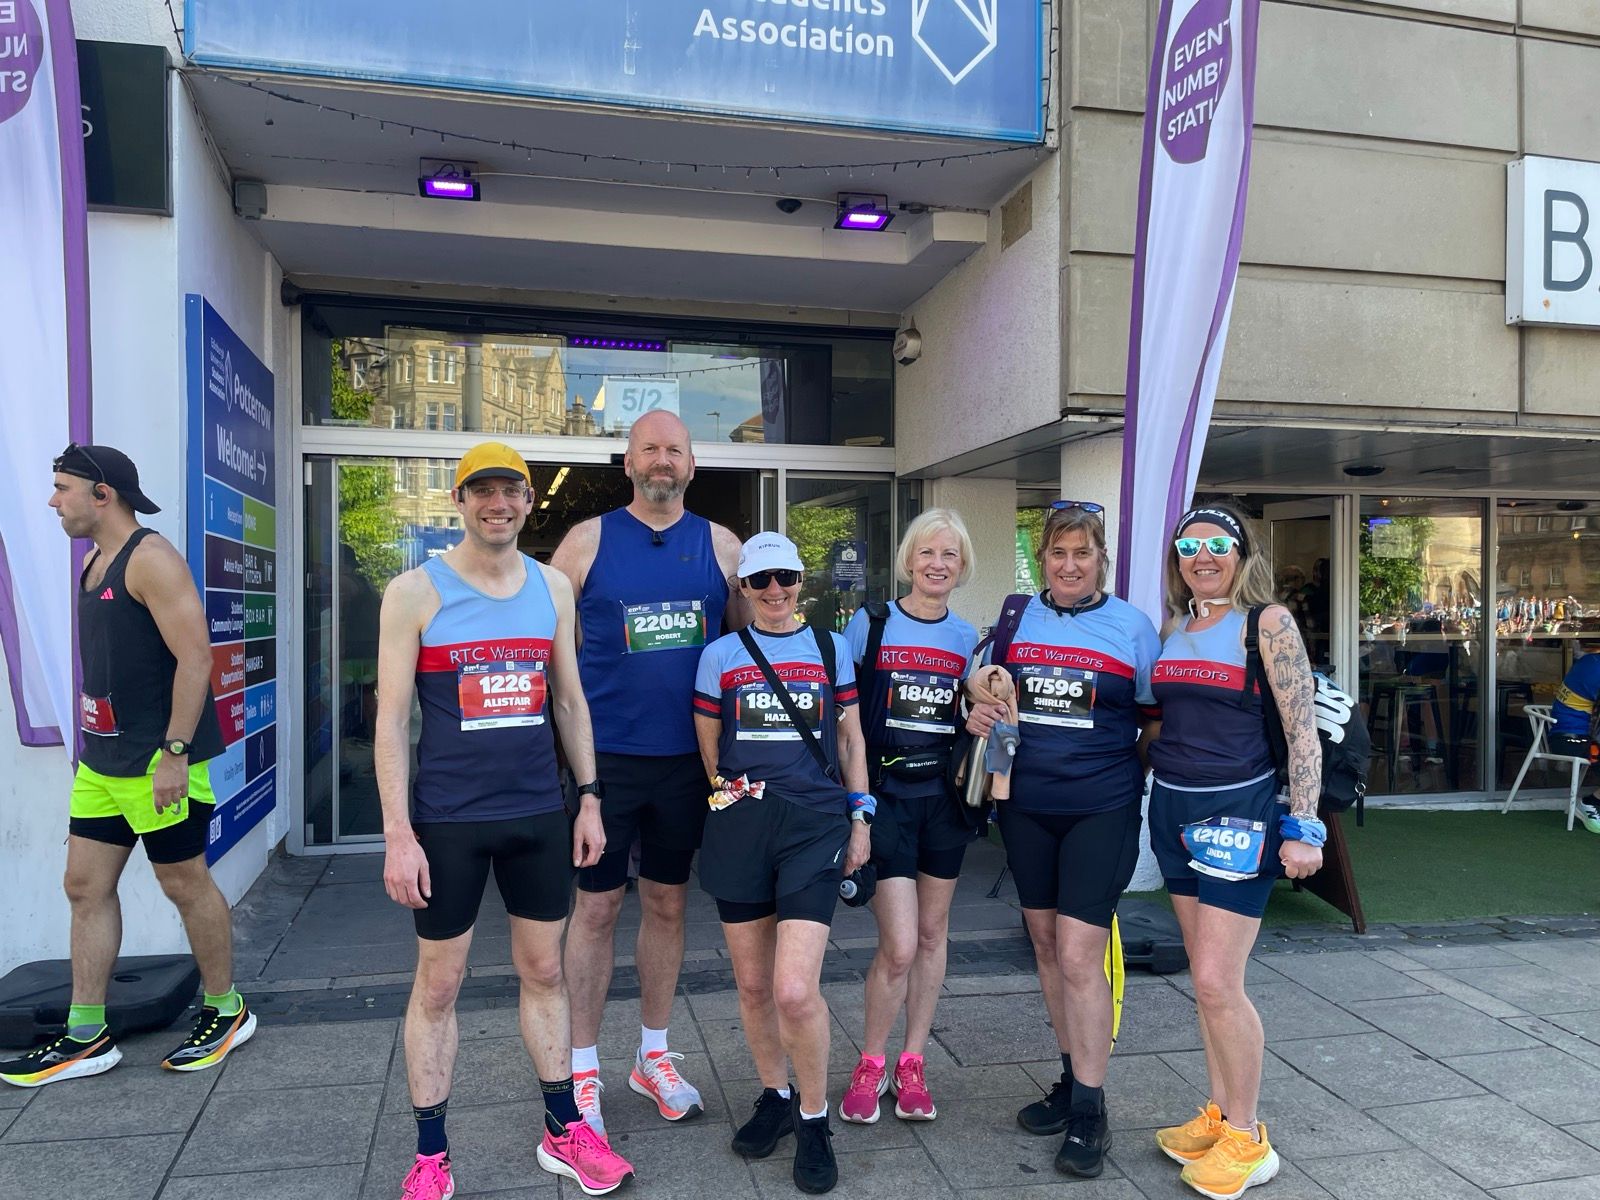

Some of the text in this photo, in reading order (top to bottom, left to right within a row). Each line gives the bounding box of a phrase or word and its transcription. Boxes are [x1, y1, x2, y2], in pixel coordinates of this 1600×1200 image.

[693, 9, 894, 58] Association
[1165, 58, 1223, 110] NUMB
[1167, 81, 1219, 141] STATI
[234, 372, 272, 431] Potterrow
[621, 388, 662, 412] 5/2
[216, 423, 256, 482] Welcome!
[245, 553, 253, 569] BAR
[246, 608, 265, 624] BOX BAR
[634, 612, 698, 633] 22043
[655, 633, 682, 641] ROBERT
[449, 643, 549, 664] RTC Warriors
[881, 650, 960, 671] RTC Warriors
[1016, 647, 1104, 669] RTC Warriors
[734, 670, 763, 683] RTC
[1165, 664, 1229, 682] Warriors
[479, 674, 532, 694] 1226
[1025, 677, 1084, 698] 17596
[483, 697, 531, 708] ALISTAIR
[898, 685, 954, 705] 18429
[1033, 697, 1082, 709] SHIRLEY
[764, 713, 792, 722] HAZE
[918, 705, 937, 715] JOY
[1193, 828, 1251, 850] 12160
